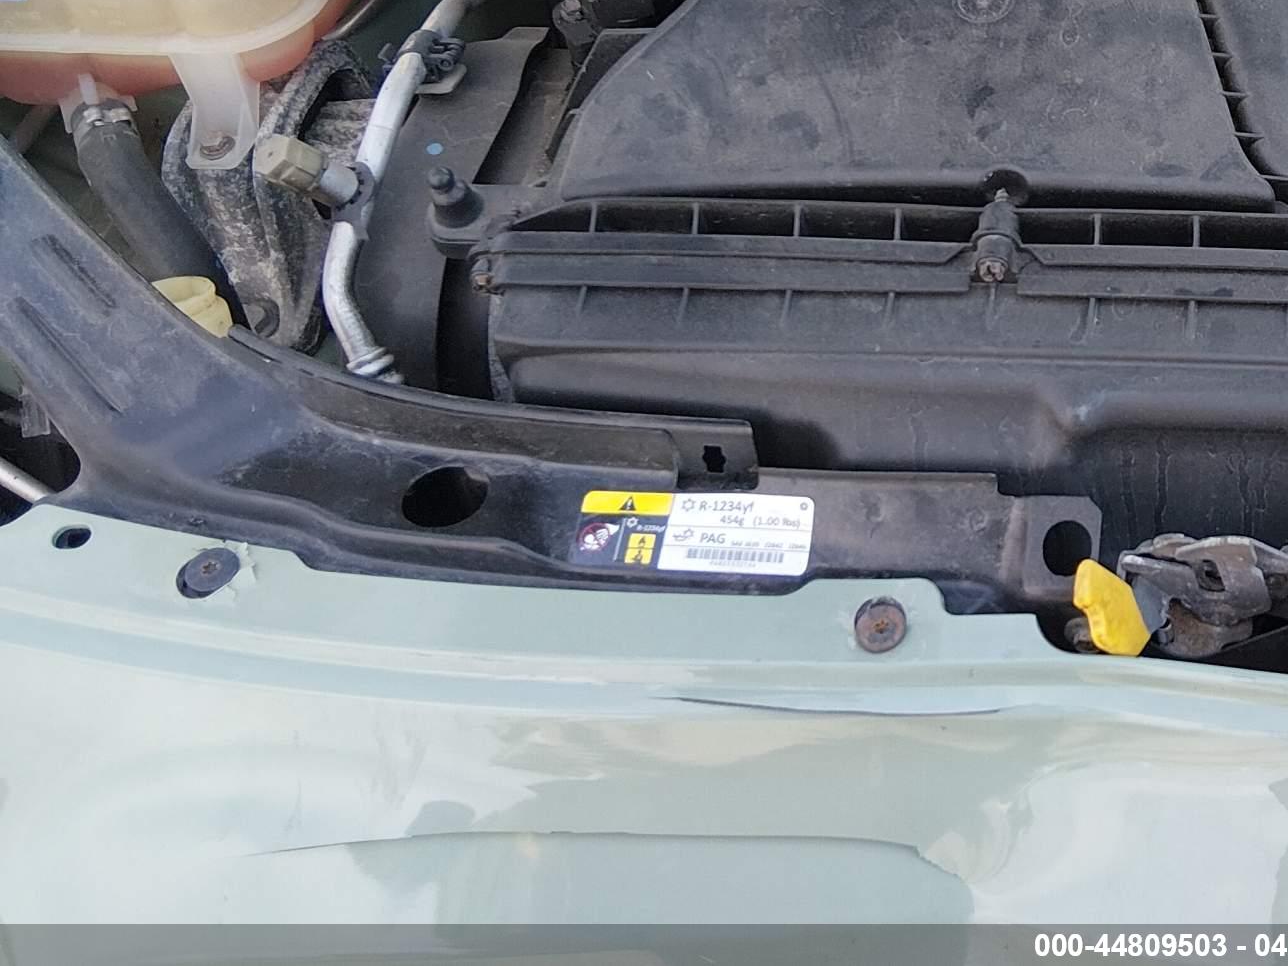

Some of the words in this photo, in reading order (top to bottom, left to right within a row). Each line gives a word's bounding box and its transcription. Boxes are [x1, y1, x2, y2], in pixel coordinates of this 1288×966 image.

[699, 500, 755, 514] R-1234yf
[719, 515, 745, 527] 454g
[700, 533, 727, 544] PAG
